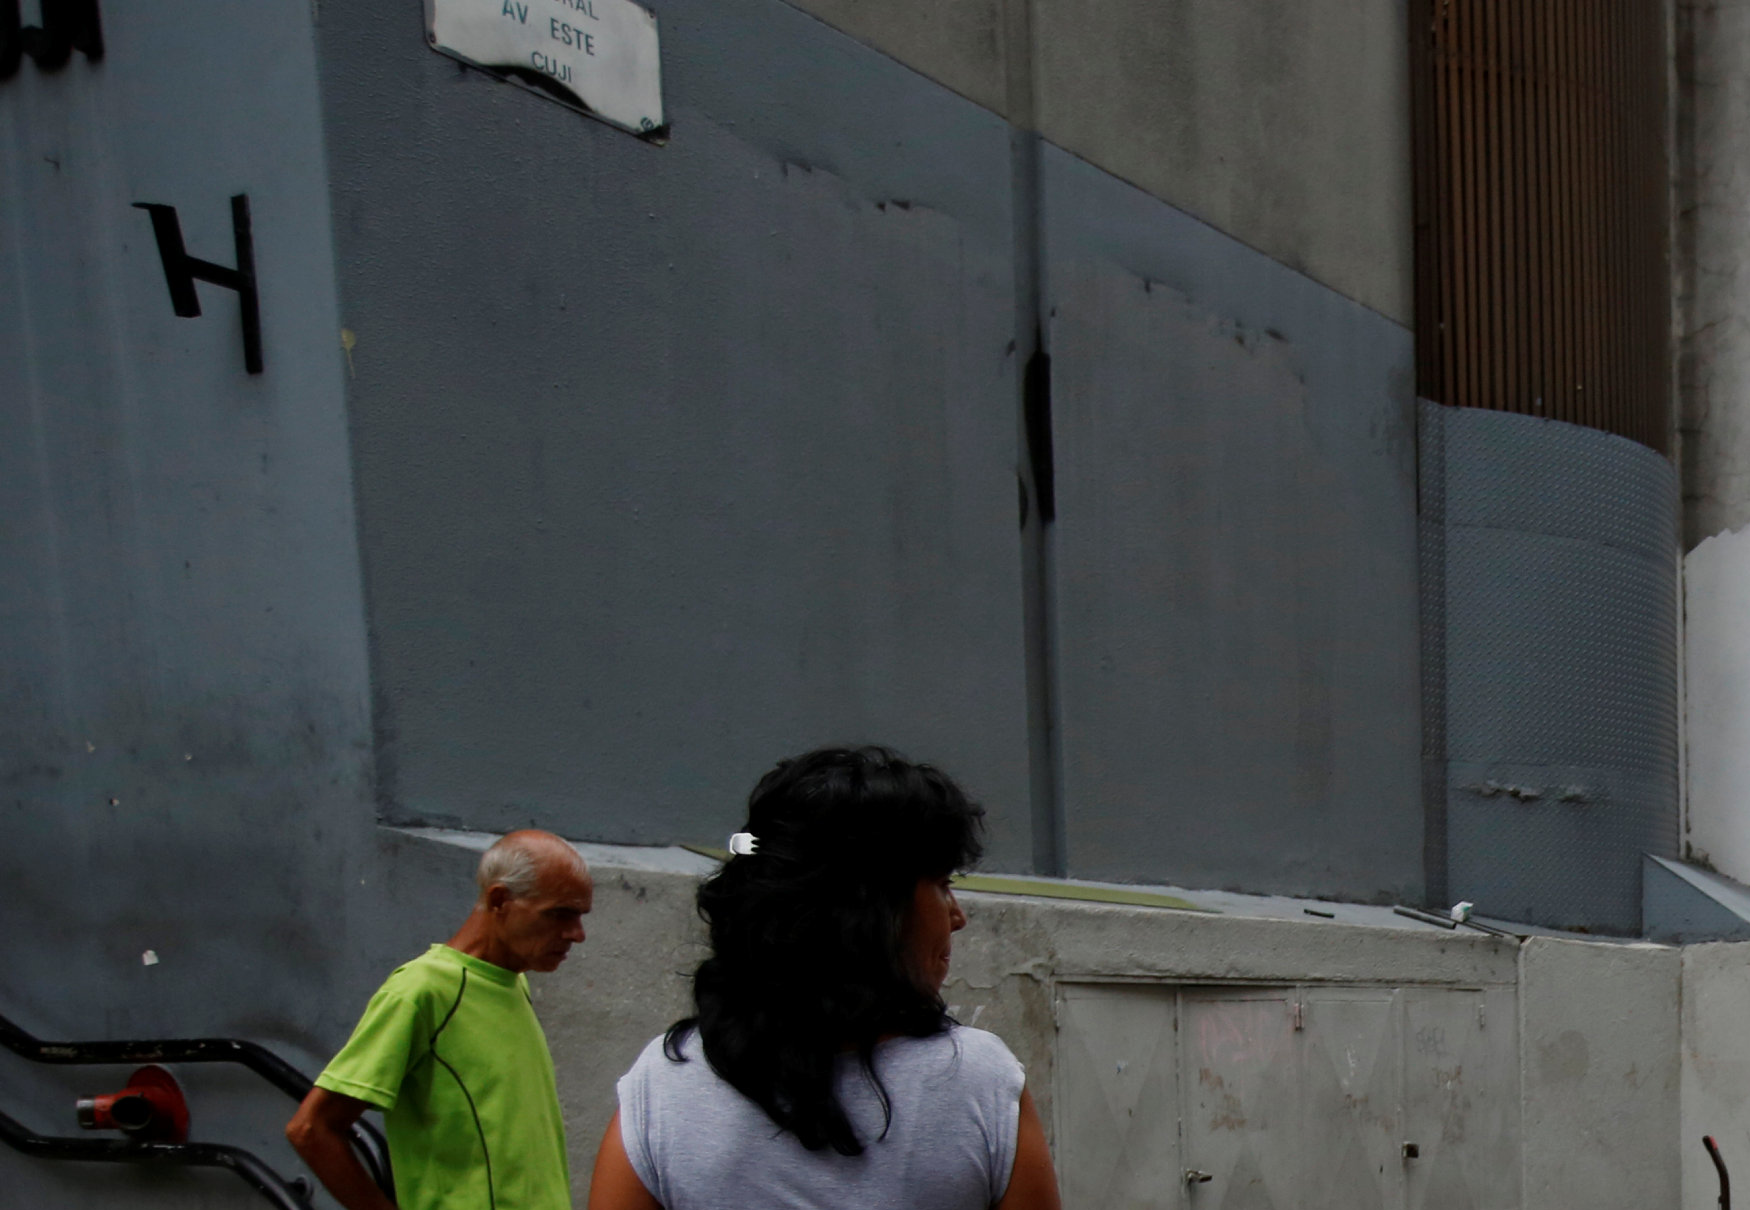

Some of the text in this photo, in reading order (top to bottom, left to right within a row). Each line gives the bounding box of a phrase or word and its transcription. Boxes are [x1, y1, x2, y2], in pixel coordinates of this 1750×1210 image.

[502, 0, 595, 56] AV ESTE
[531, 51, 572, 83] CUJI
